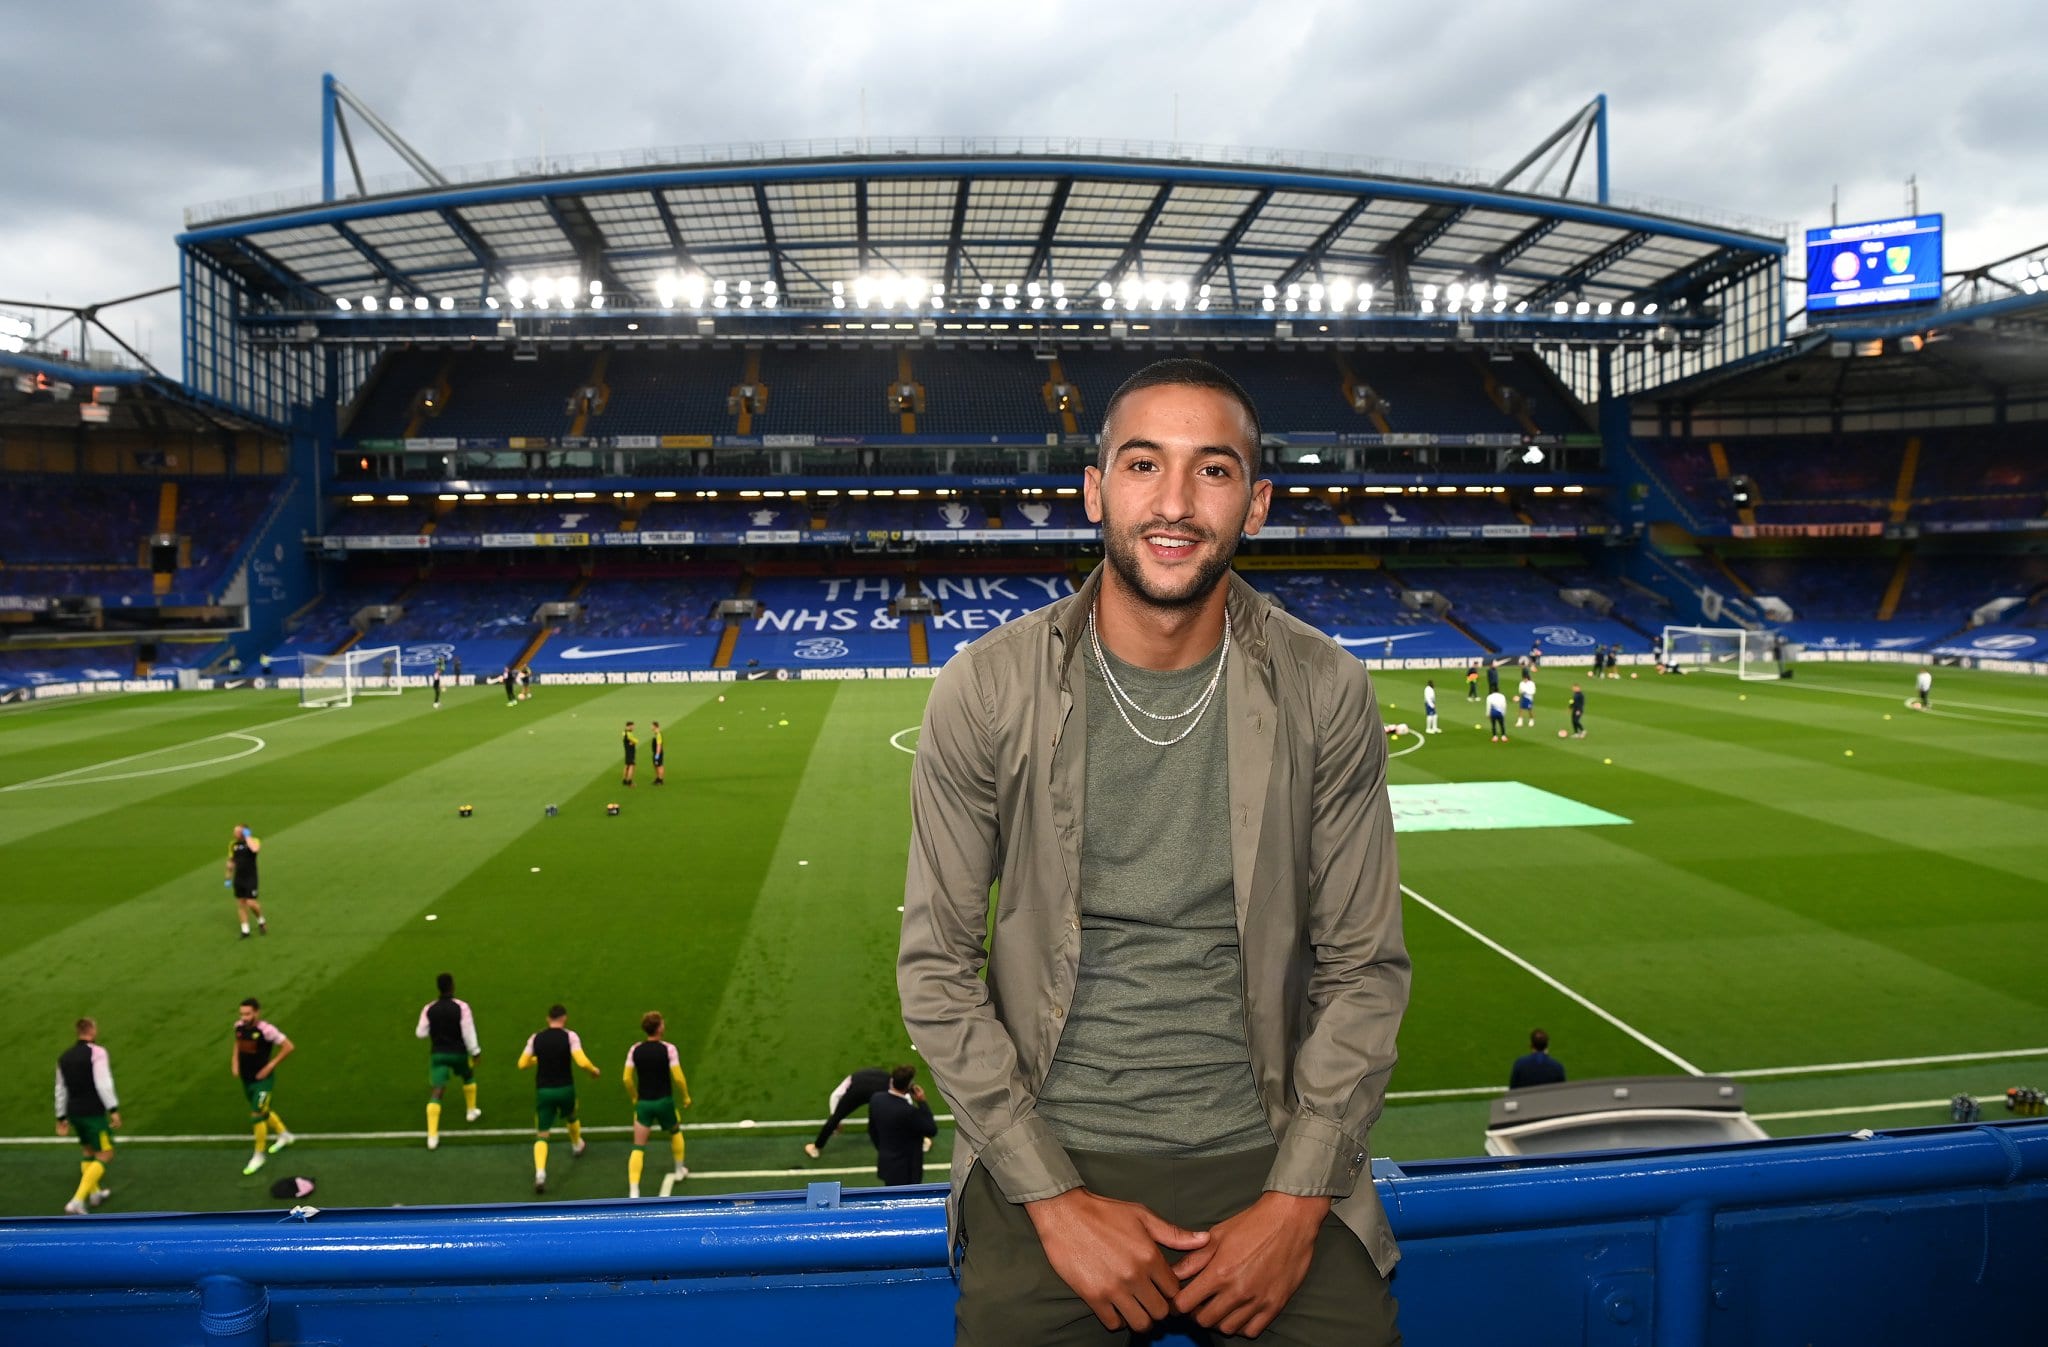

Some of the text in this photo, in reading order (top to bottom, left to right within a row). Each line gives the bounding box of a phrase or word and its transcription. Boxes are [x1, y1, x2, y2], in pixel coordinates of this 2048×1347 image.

[972, 478, 1016, 486] CHELSEA FC
[755, 608, 858, 631] NHS
[870, 607, 900, 629] &
[540, 670, 737, 685] INTRODUCING THE NEW CHELSEA HOME KIT
[801, 668, 865, 680] INTRODUCING
[866, 668, 884, 679] THE
[886, 667, 909, 679] NEW
